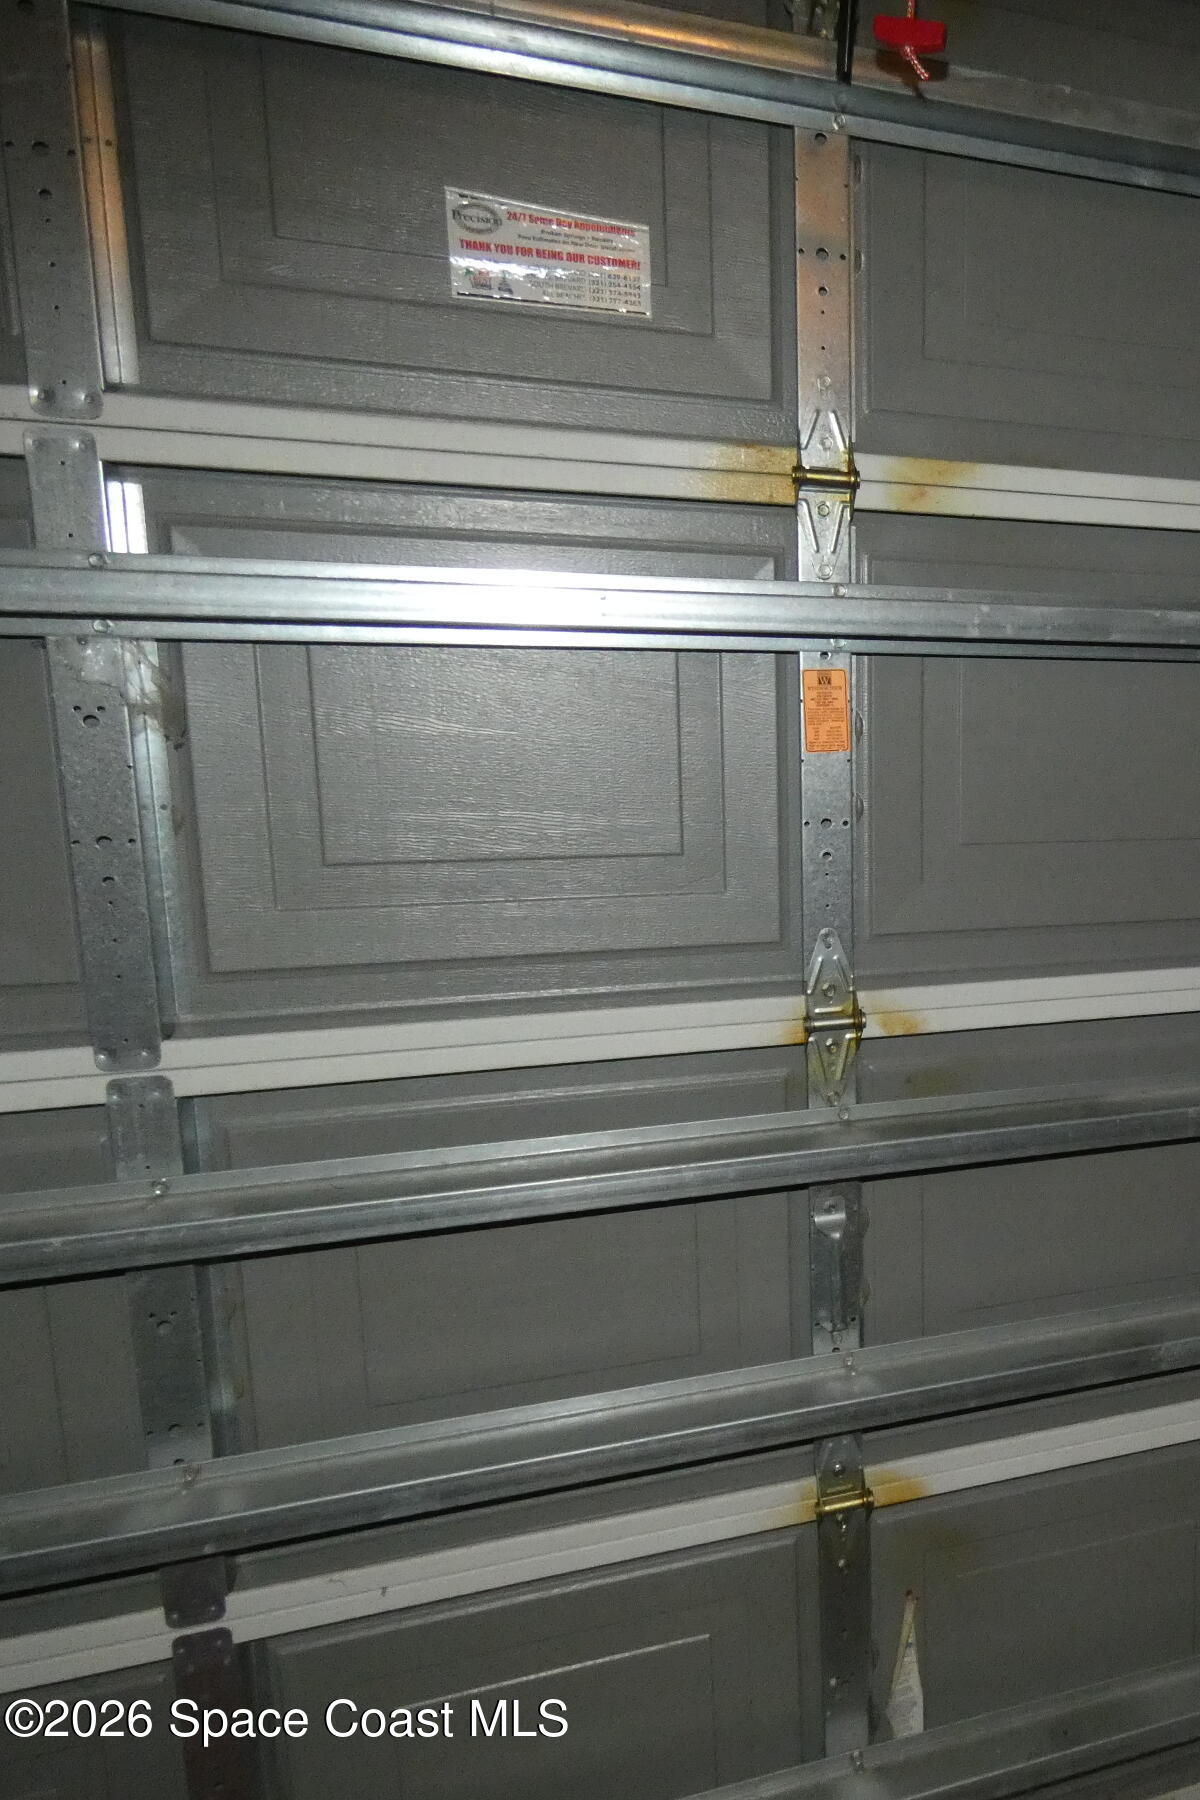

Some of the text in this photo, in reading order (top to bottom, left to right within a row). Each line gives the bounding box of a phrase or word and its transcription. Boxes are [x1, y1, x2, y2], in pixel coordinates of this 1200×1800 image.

[460, 239, 640, 270] THANK YOU FOR BEING OUR CUSTOMER!
